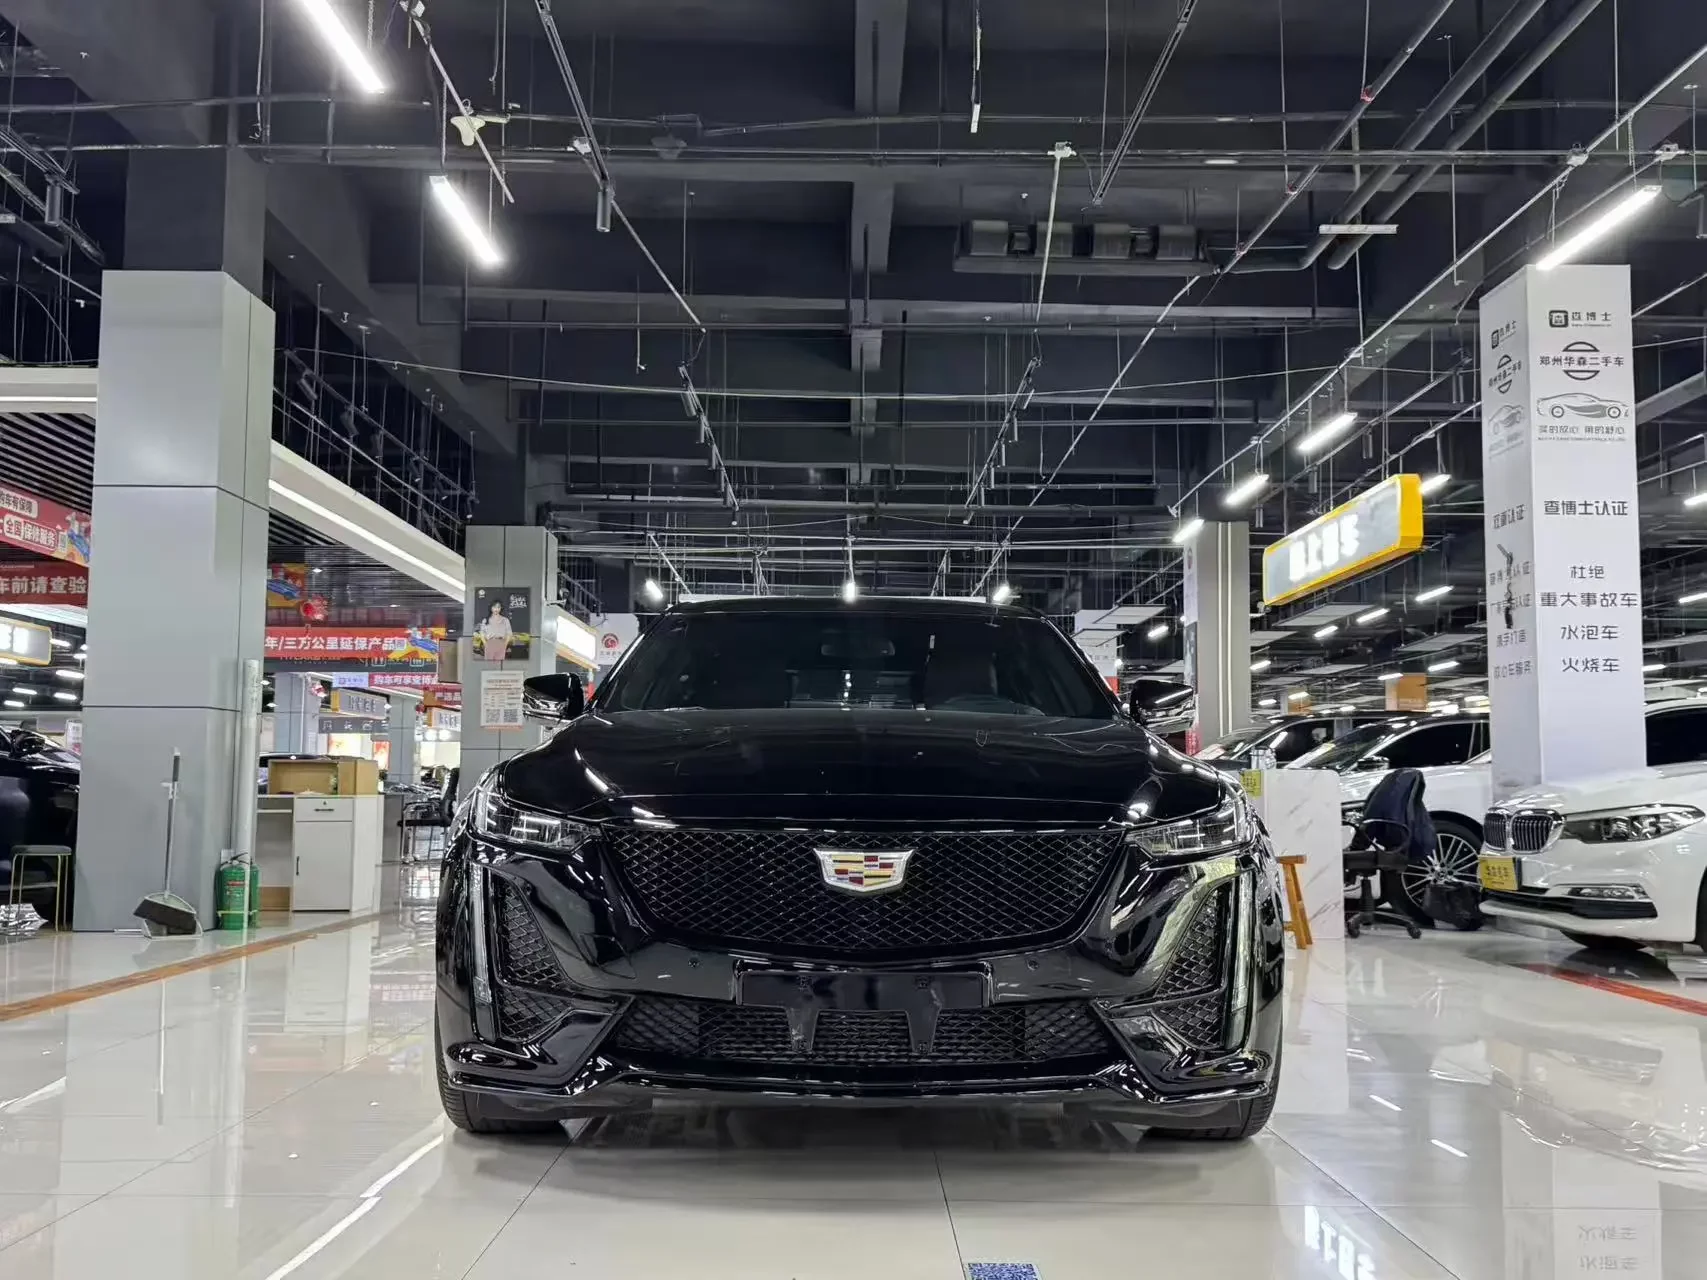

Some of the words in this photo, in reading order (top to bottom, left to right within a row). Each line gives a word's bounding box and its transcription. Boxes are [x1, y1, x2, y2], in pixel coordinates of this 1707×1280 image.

[1539, 356, 1624, 367] 郑州华森二手车
[1544, 500, 1629, 516] 查博士认证
[1570, 565, 1605, 579] 杜绝
[1540, 592, 1638, 607] 重大事故车
[1561, 625, 1619, 640] 水泡车
[1562, 657, 1620, 673] 火烧车
